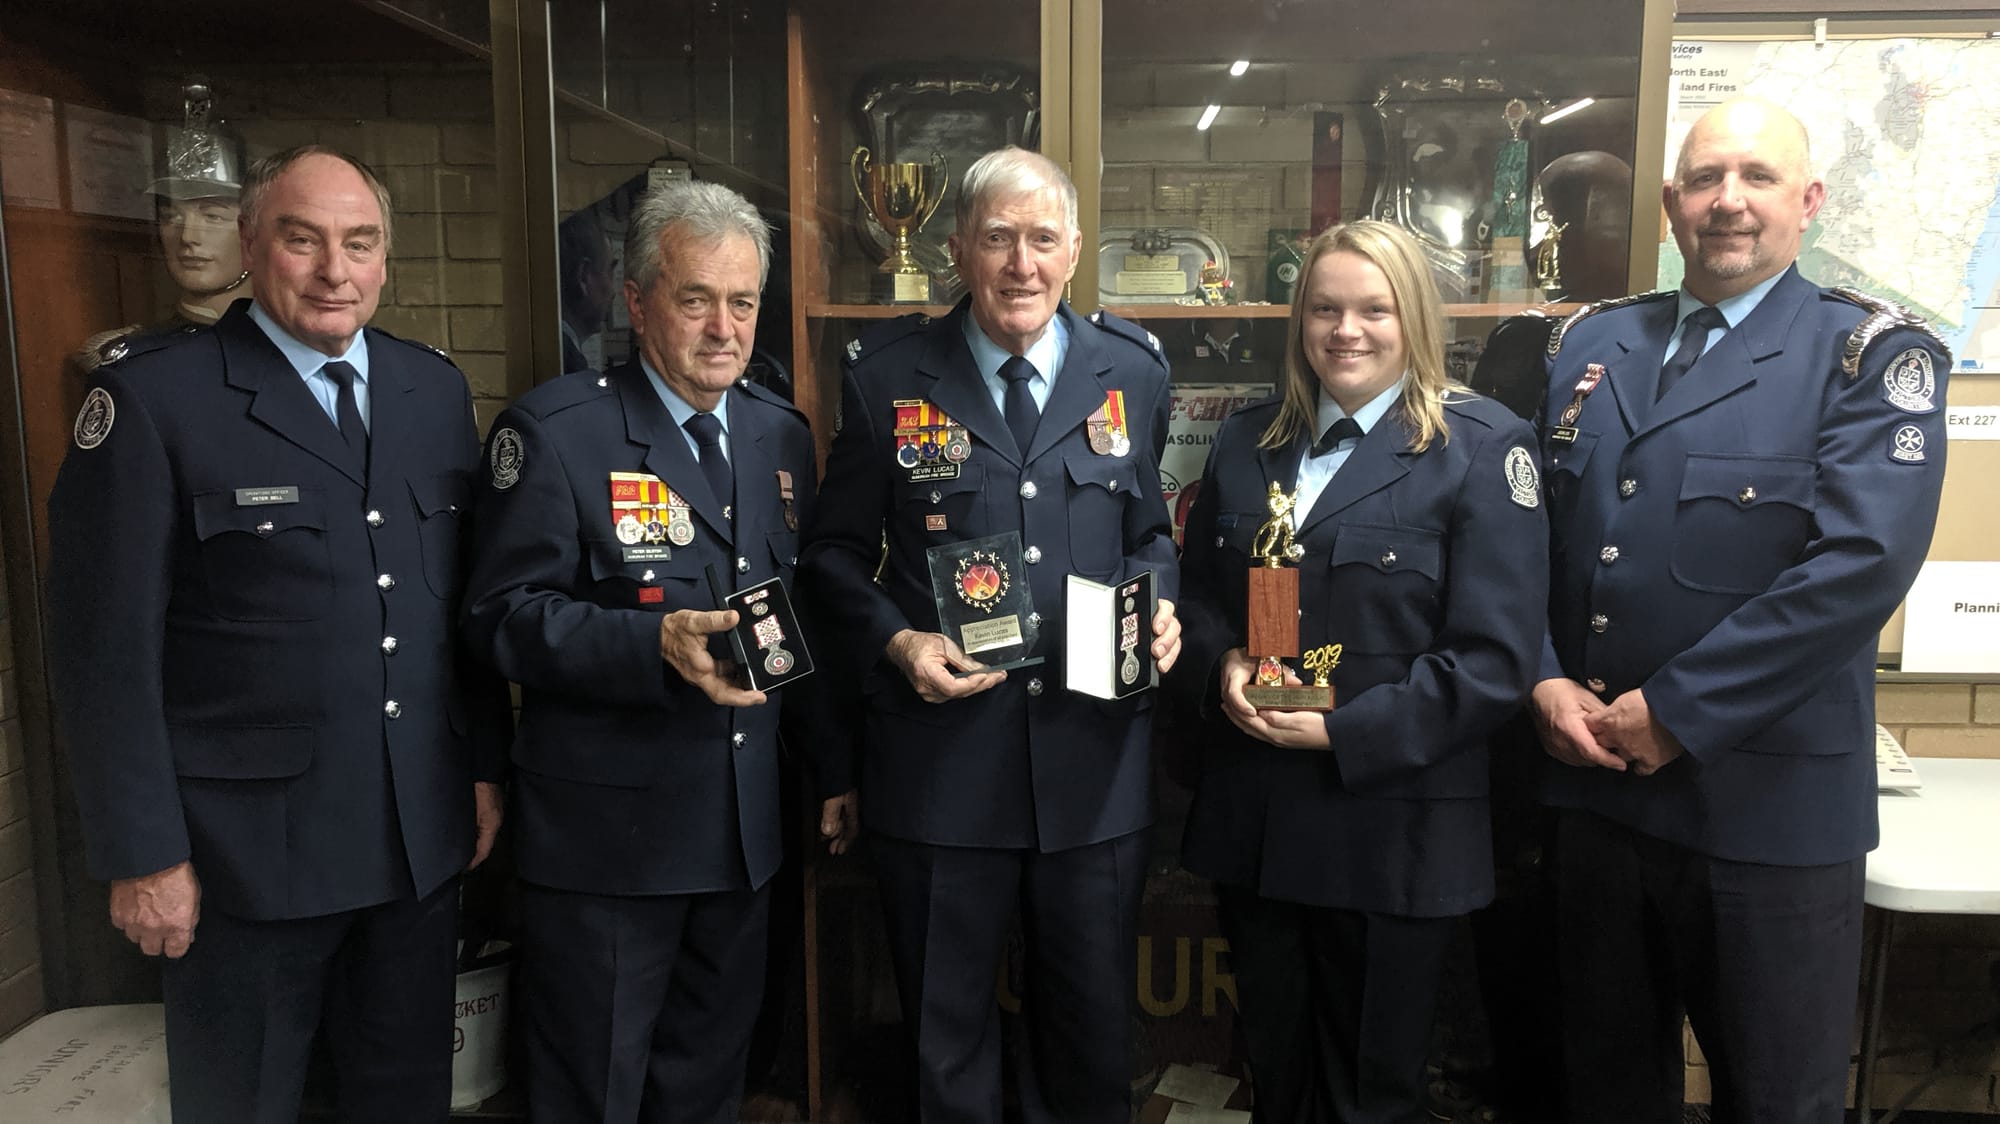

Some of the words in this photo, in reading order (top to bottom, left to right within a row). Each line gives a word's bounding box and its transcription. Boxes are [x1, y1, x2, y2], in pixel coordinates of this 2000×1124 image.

[1699, 68, 1729, 77] East/
[1679, 82, 1706, 92] land
[1708, 82, 1737, 92] Fires
[1948, 414, 1970, 425] Ext
[1973, 415, 1997, 426] 227
[912, 467, 931, 475] KEVIN
[933, 465, 955, 473] LUCAS
[1954, 602, 2000, 613] Planni
[1303, 643, 1343, 670] 2019
